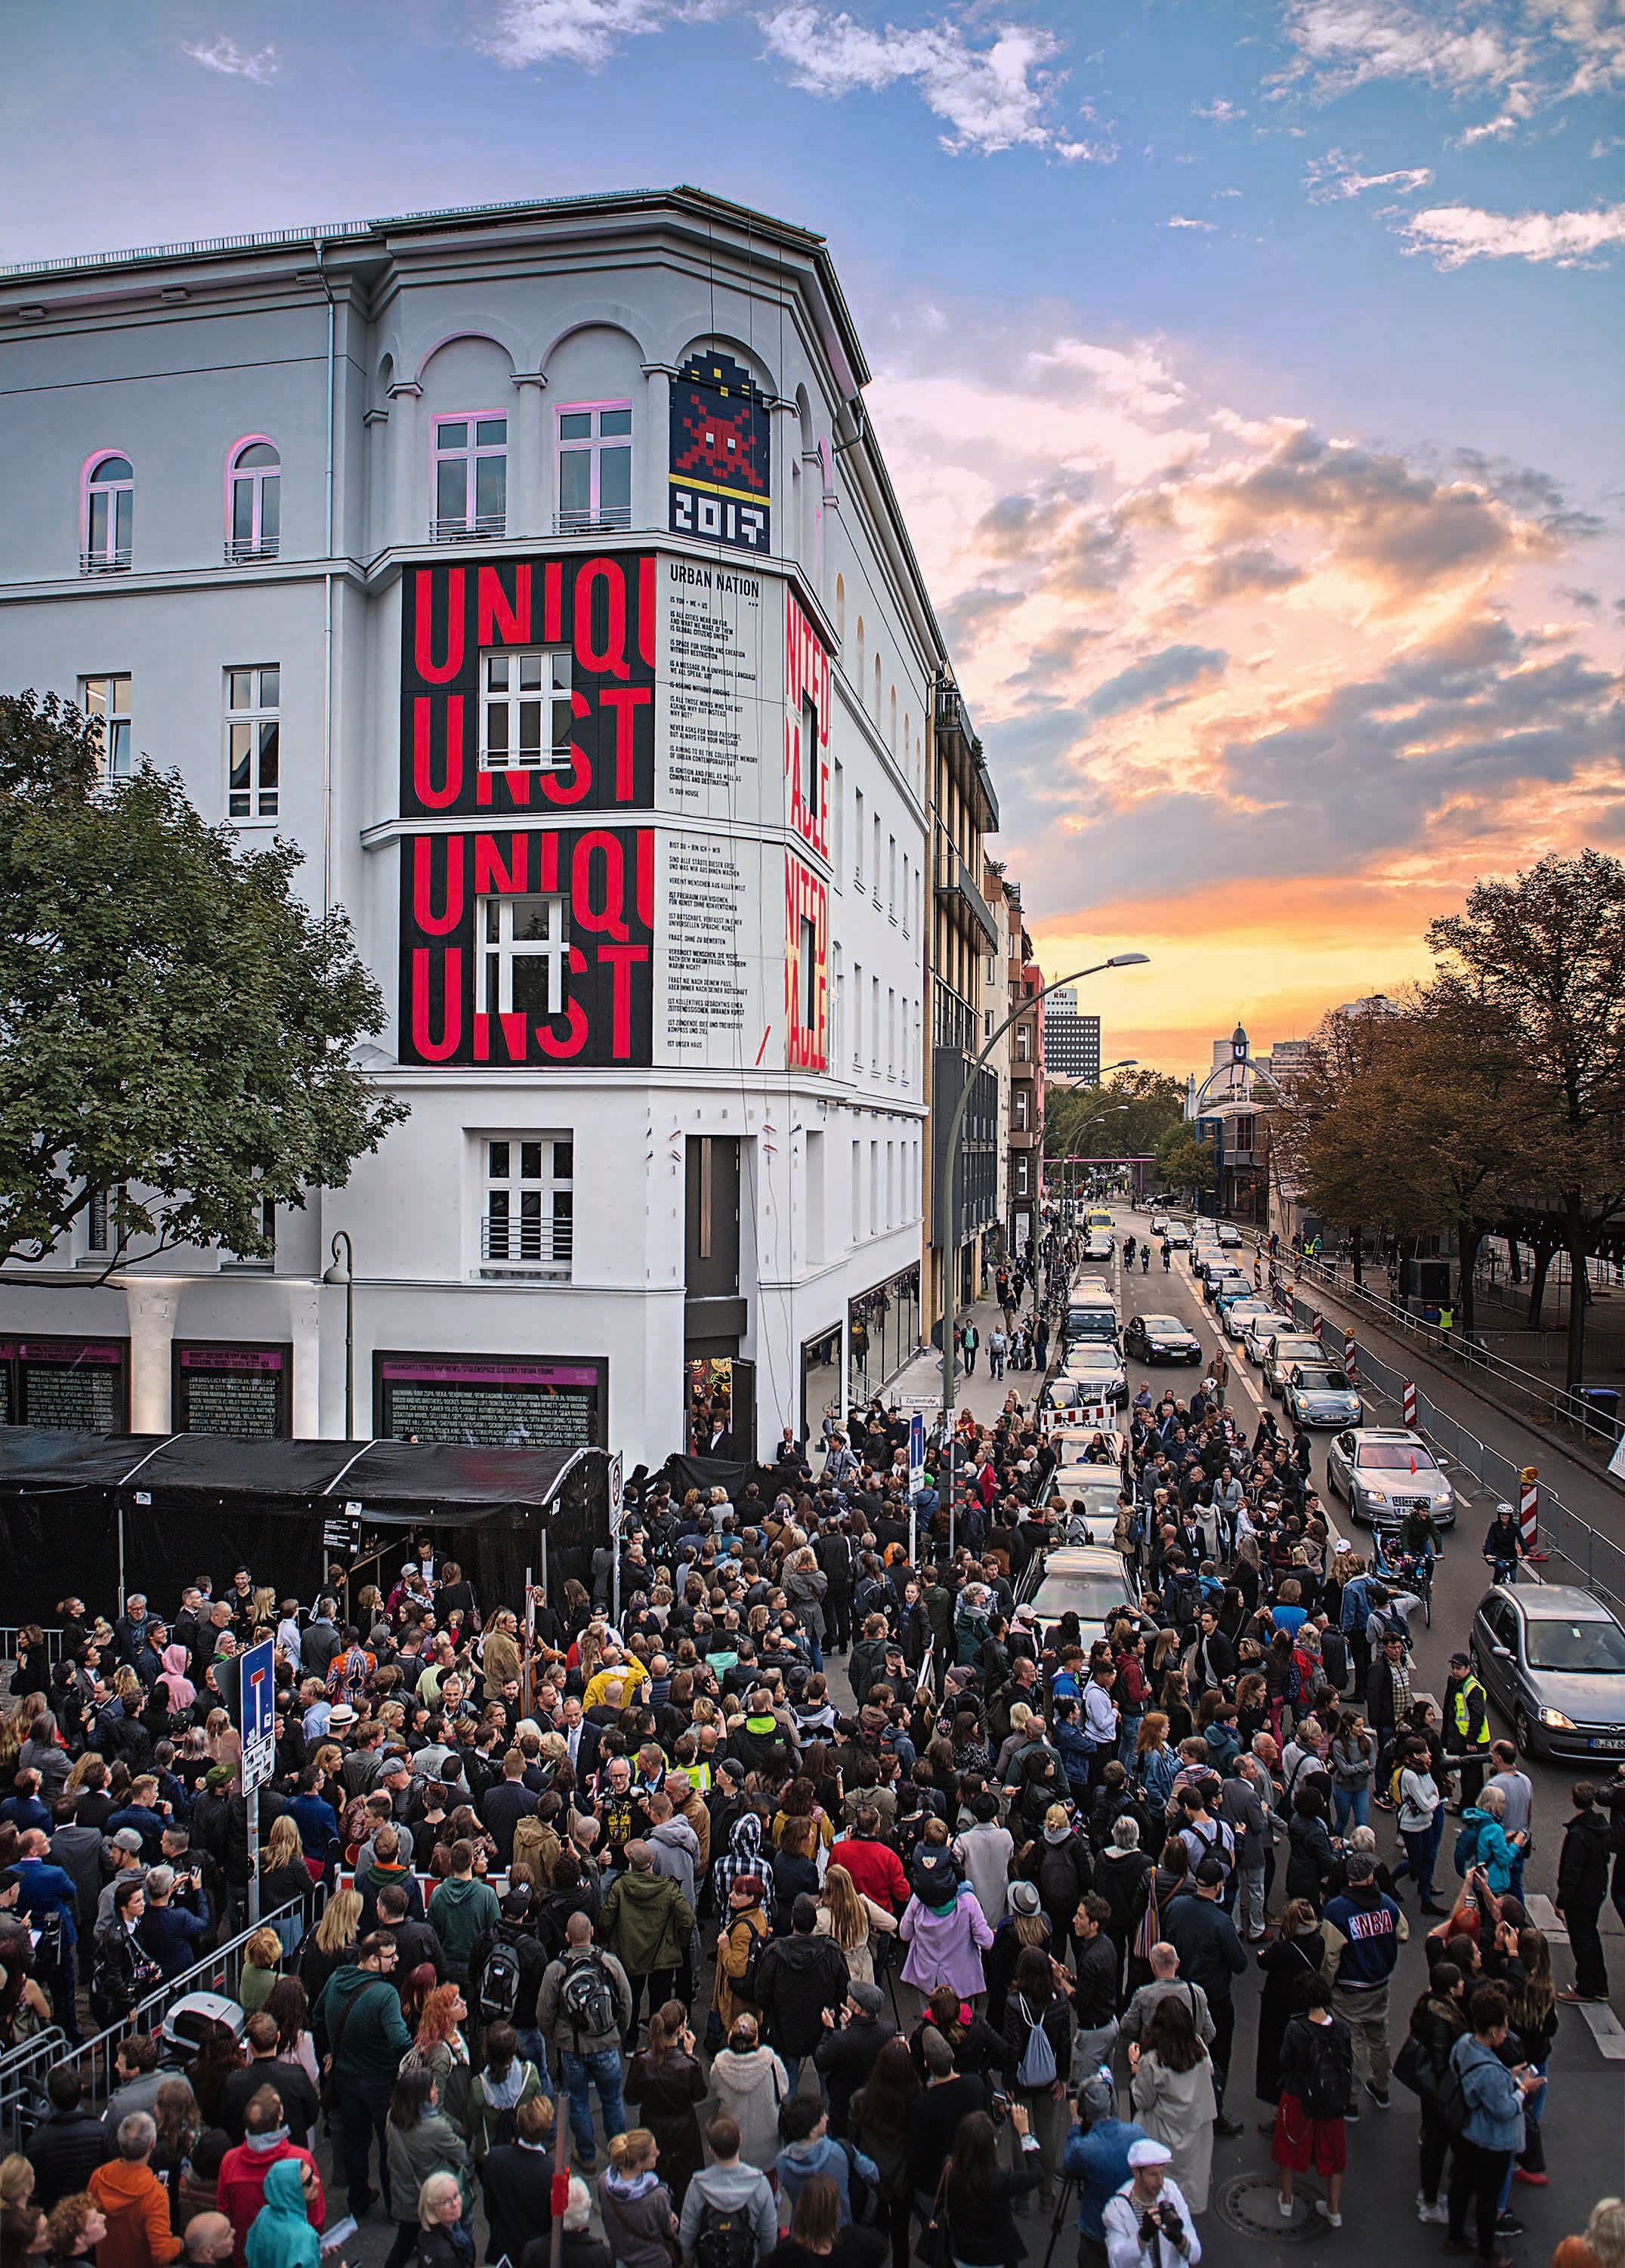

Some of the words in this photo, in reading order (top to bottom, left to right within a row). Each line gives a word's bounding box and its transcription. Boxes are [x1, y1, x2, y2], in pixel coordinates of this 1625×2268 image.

[676, 492, 764, 544] 2017
[670, 564, 712, 589] URBAN
[717, 574, 759, 598] NATION
[1235, 1046, 1244, 1056] U
[1356, 1909, 1393, 1939] NBA
